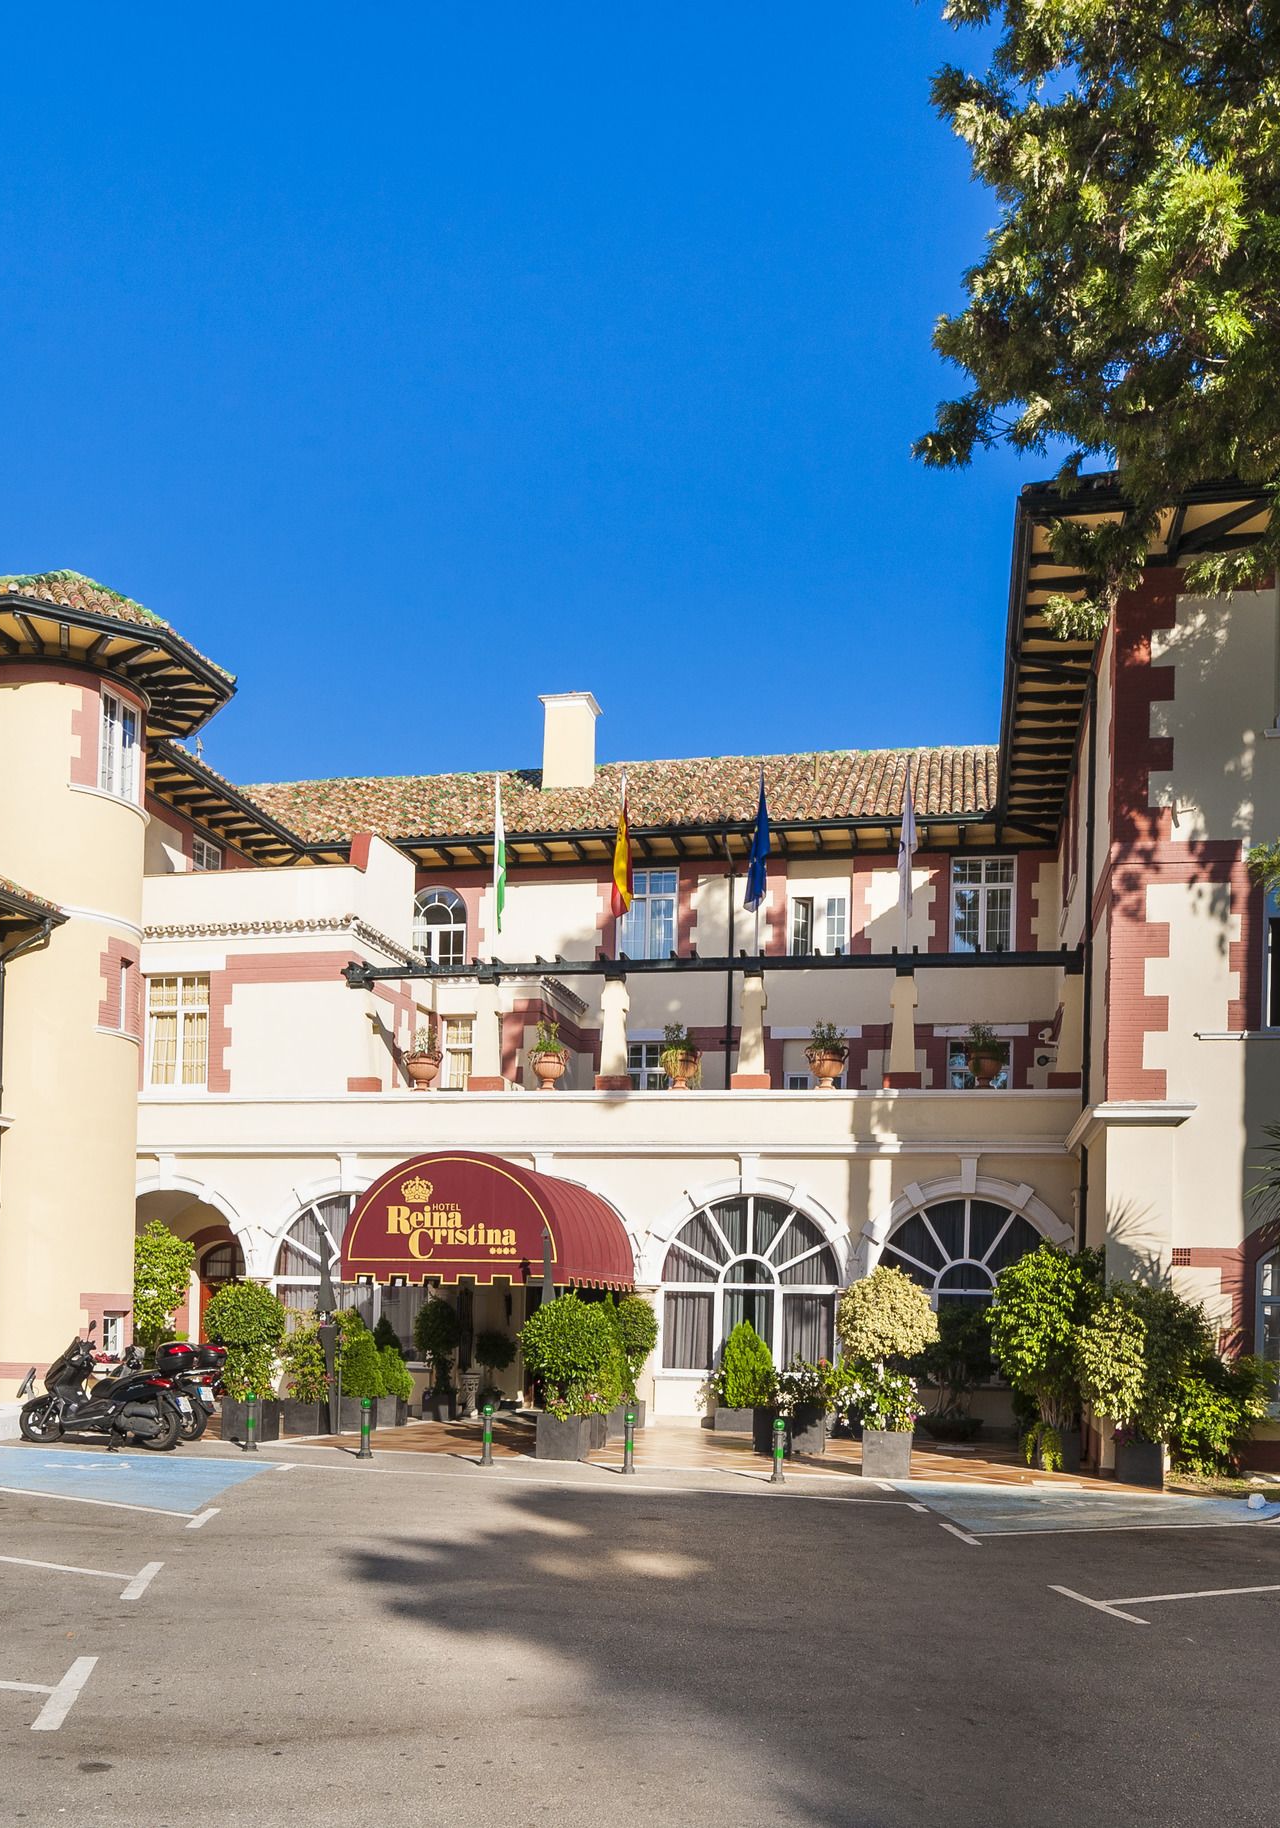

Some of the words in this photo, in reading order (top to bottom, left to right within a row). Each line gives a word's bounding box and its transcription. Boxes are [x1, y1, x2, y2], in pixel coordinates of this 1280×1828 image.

[386, 1205, 463, 1235] Reina
[432, 1203, 461, 1211] HOTEL
[408, 1223, 517, 1259] Cristina
